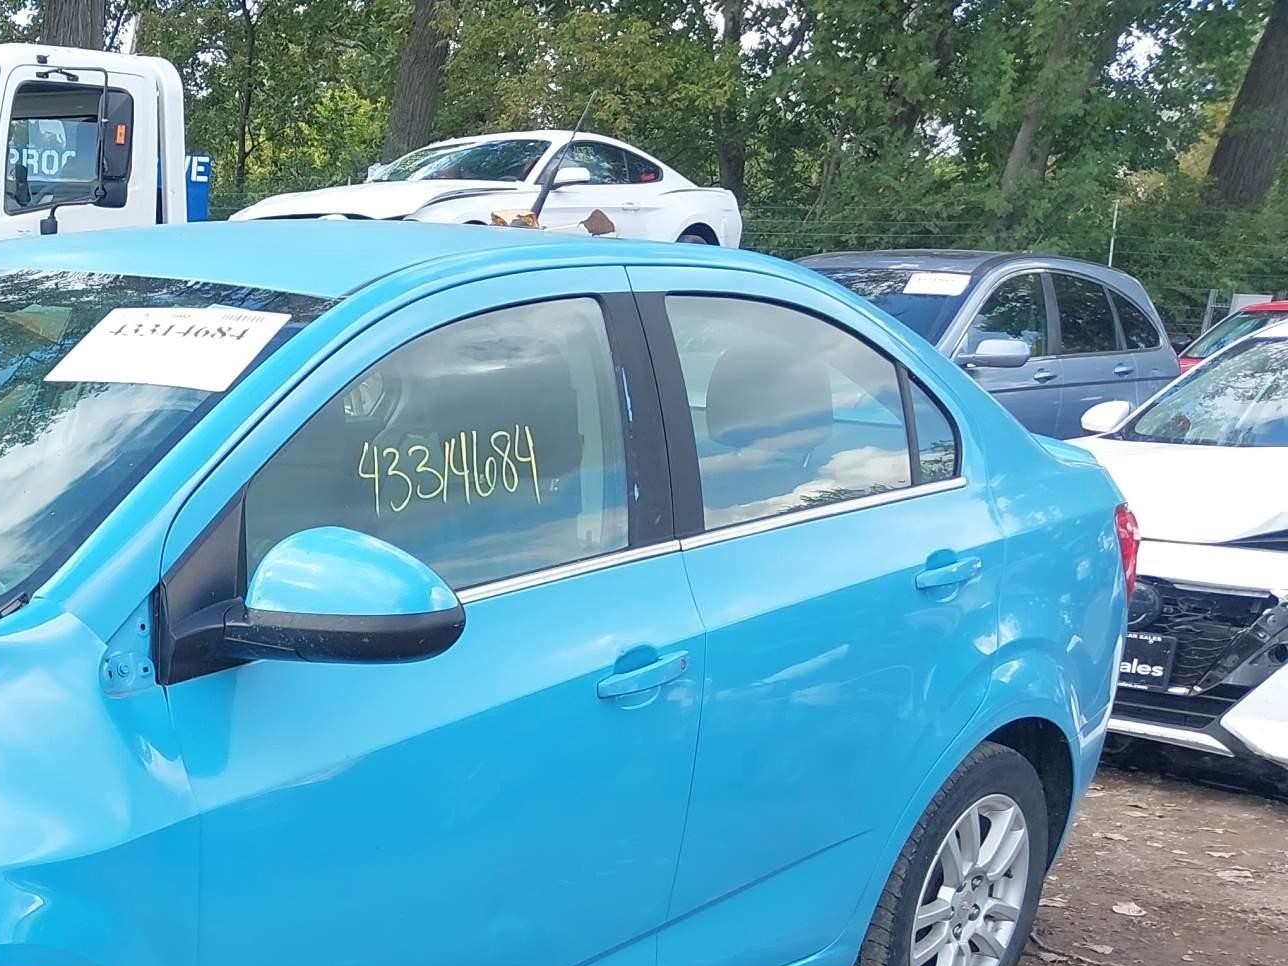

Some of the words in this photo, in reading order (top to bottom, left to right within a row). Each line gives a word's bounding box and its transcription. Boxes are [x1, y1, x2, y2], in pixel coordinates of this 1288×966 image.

[108, 323, 250, 341] 43314684
[358, 424, 542, 518] 43314684
[1119, 658, 1164, 677] ales
